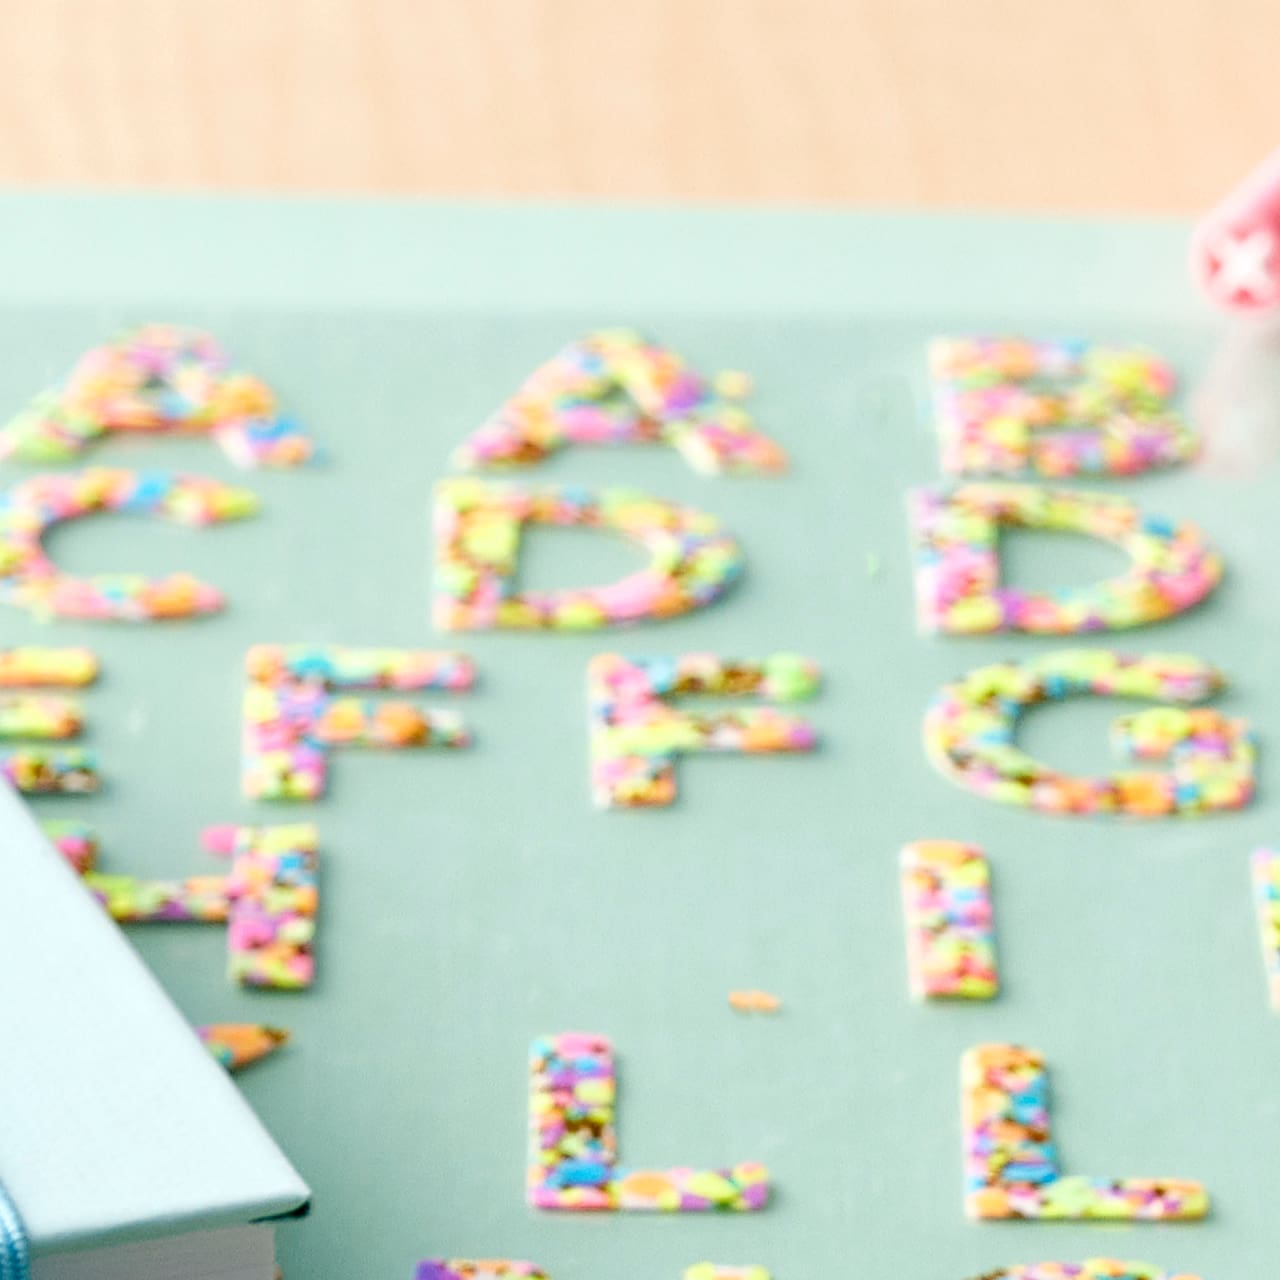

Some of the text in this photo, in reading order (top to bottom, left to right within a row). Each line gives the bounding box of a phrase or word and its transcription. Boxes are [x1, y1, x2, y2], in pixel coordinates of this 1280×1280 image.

[455, 329, 789, 474] A
[927, 337, 1203, 478] B
[432, 478, 748, 632] D
[905, 485, 1226, 634] D
[241, 645, 477, 800] F
[587, 653, 824, 808] F
[923, 650, 1260, 818] G
[529, 1033, 772, 1212] L
[961, 1043, 1210, 1221] L
